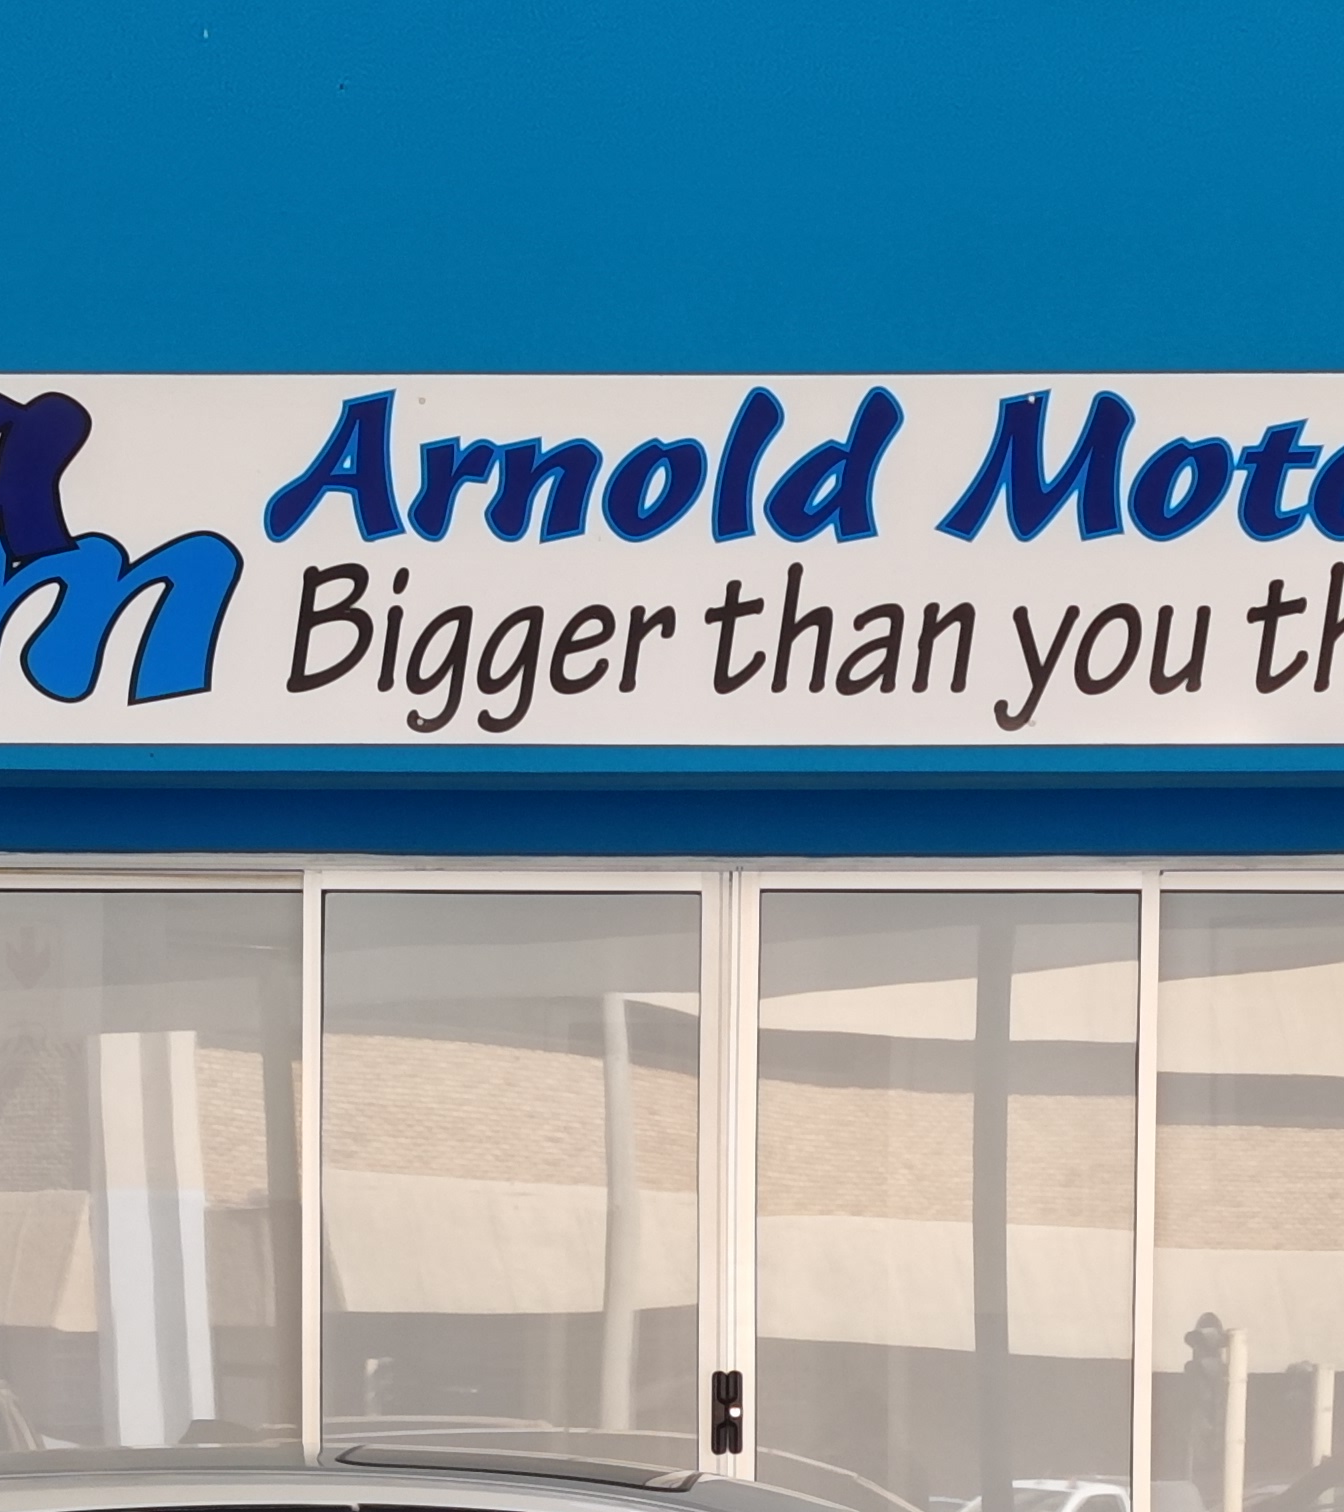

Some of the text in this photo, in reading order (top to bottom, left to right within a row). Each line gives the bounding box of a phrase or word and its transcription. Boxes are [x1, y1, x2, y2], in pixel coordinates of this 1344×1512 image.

[264, 387, 904, 543] Arnold
[287, 562, 676, 733] Bigger
[704, 561, 975, 696] than
[994, 602, 1211, 731] you
